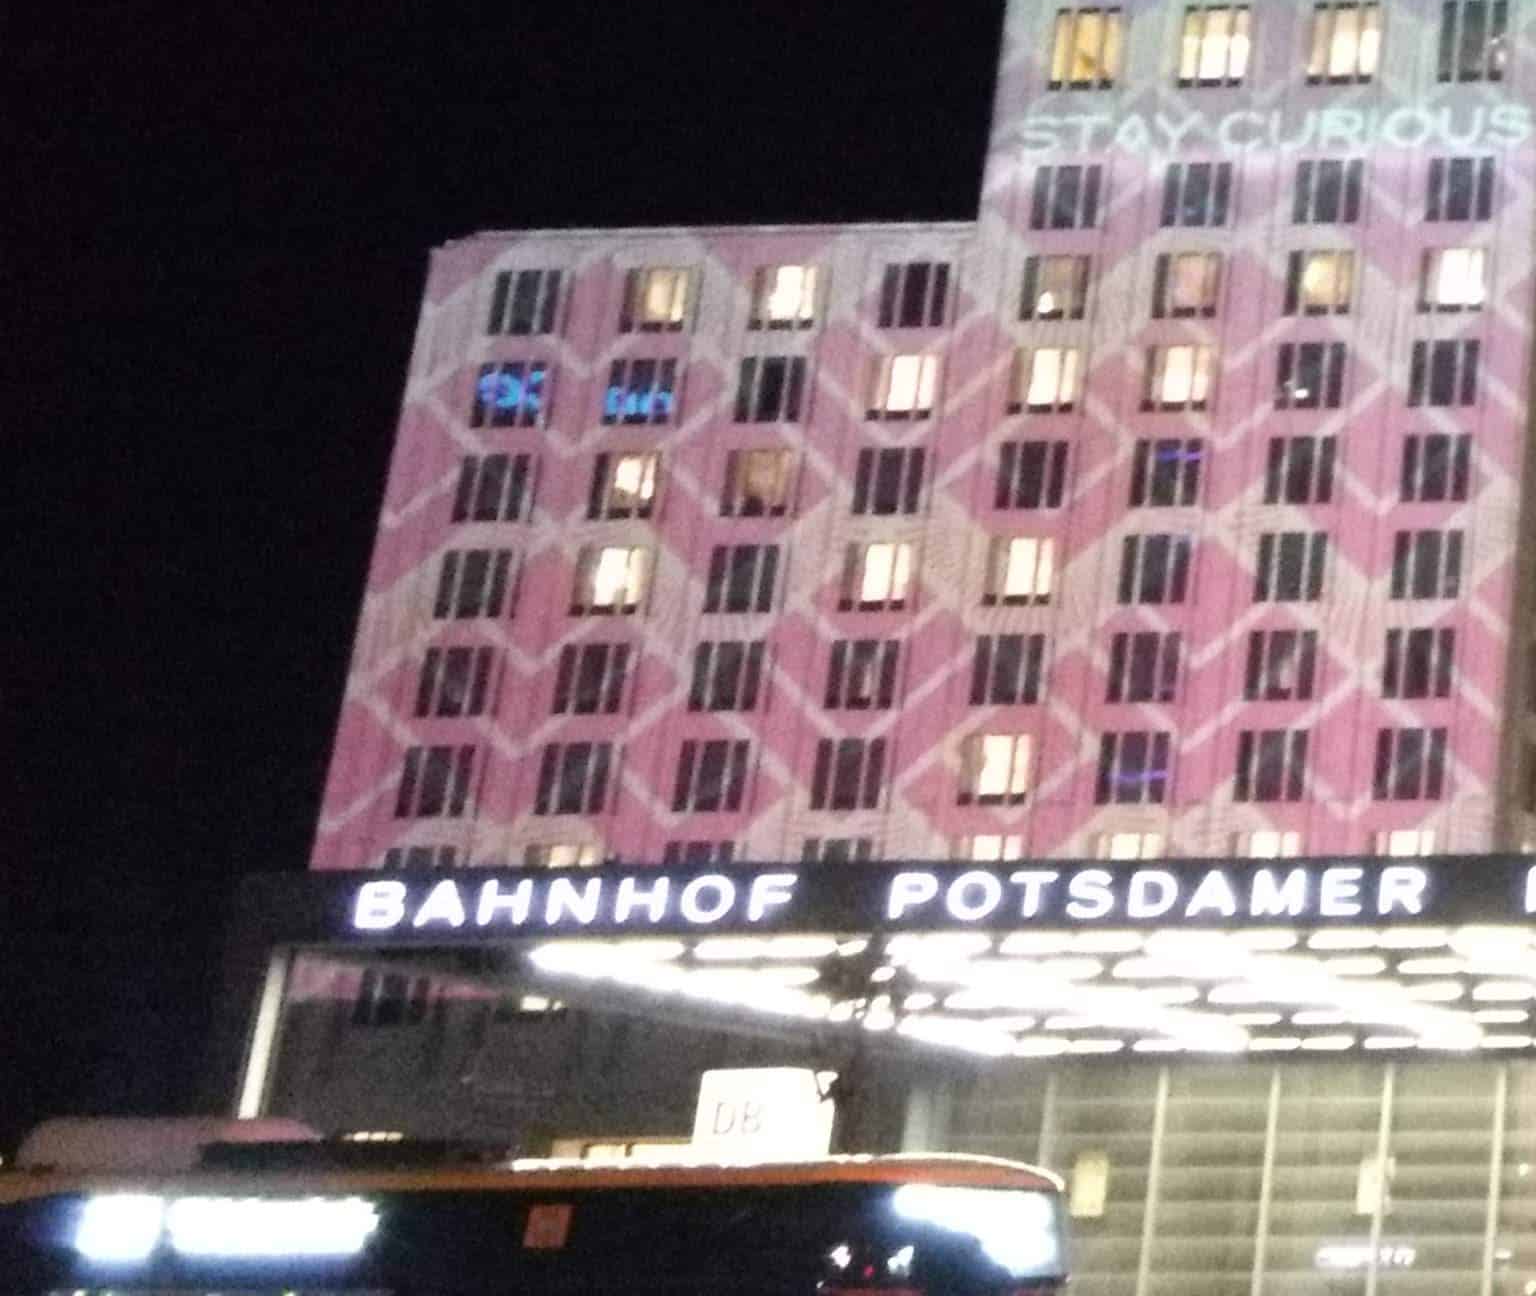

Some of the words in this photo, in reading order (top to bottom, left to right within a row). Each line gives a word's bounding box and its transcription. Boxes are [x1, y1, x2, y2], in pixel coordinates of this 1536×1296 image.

[1020, 111, 1200, 155] STAY
[1218, 104, 1534, 152] CURIOUS
[352, 872, 799, 930] BAHNHOF
[885, 864, 1429, 921] POTSDAMER
[712, 1097, 762, 1136] DB
